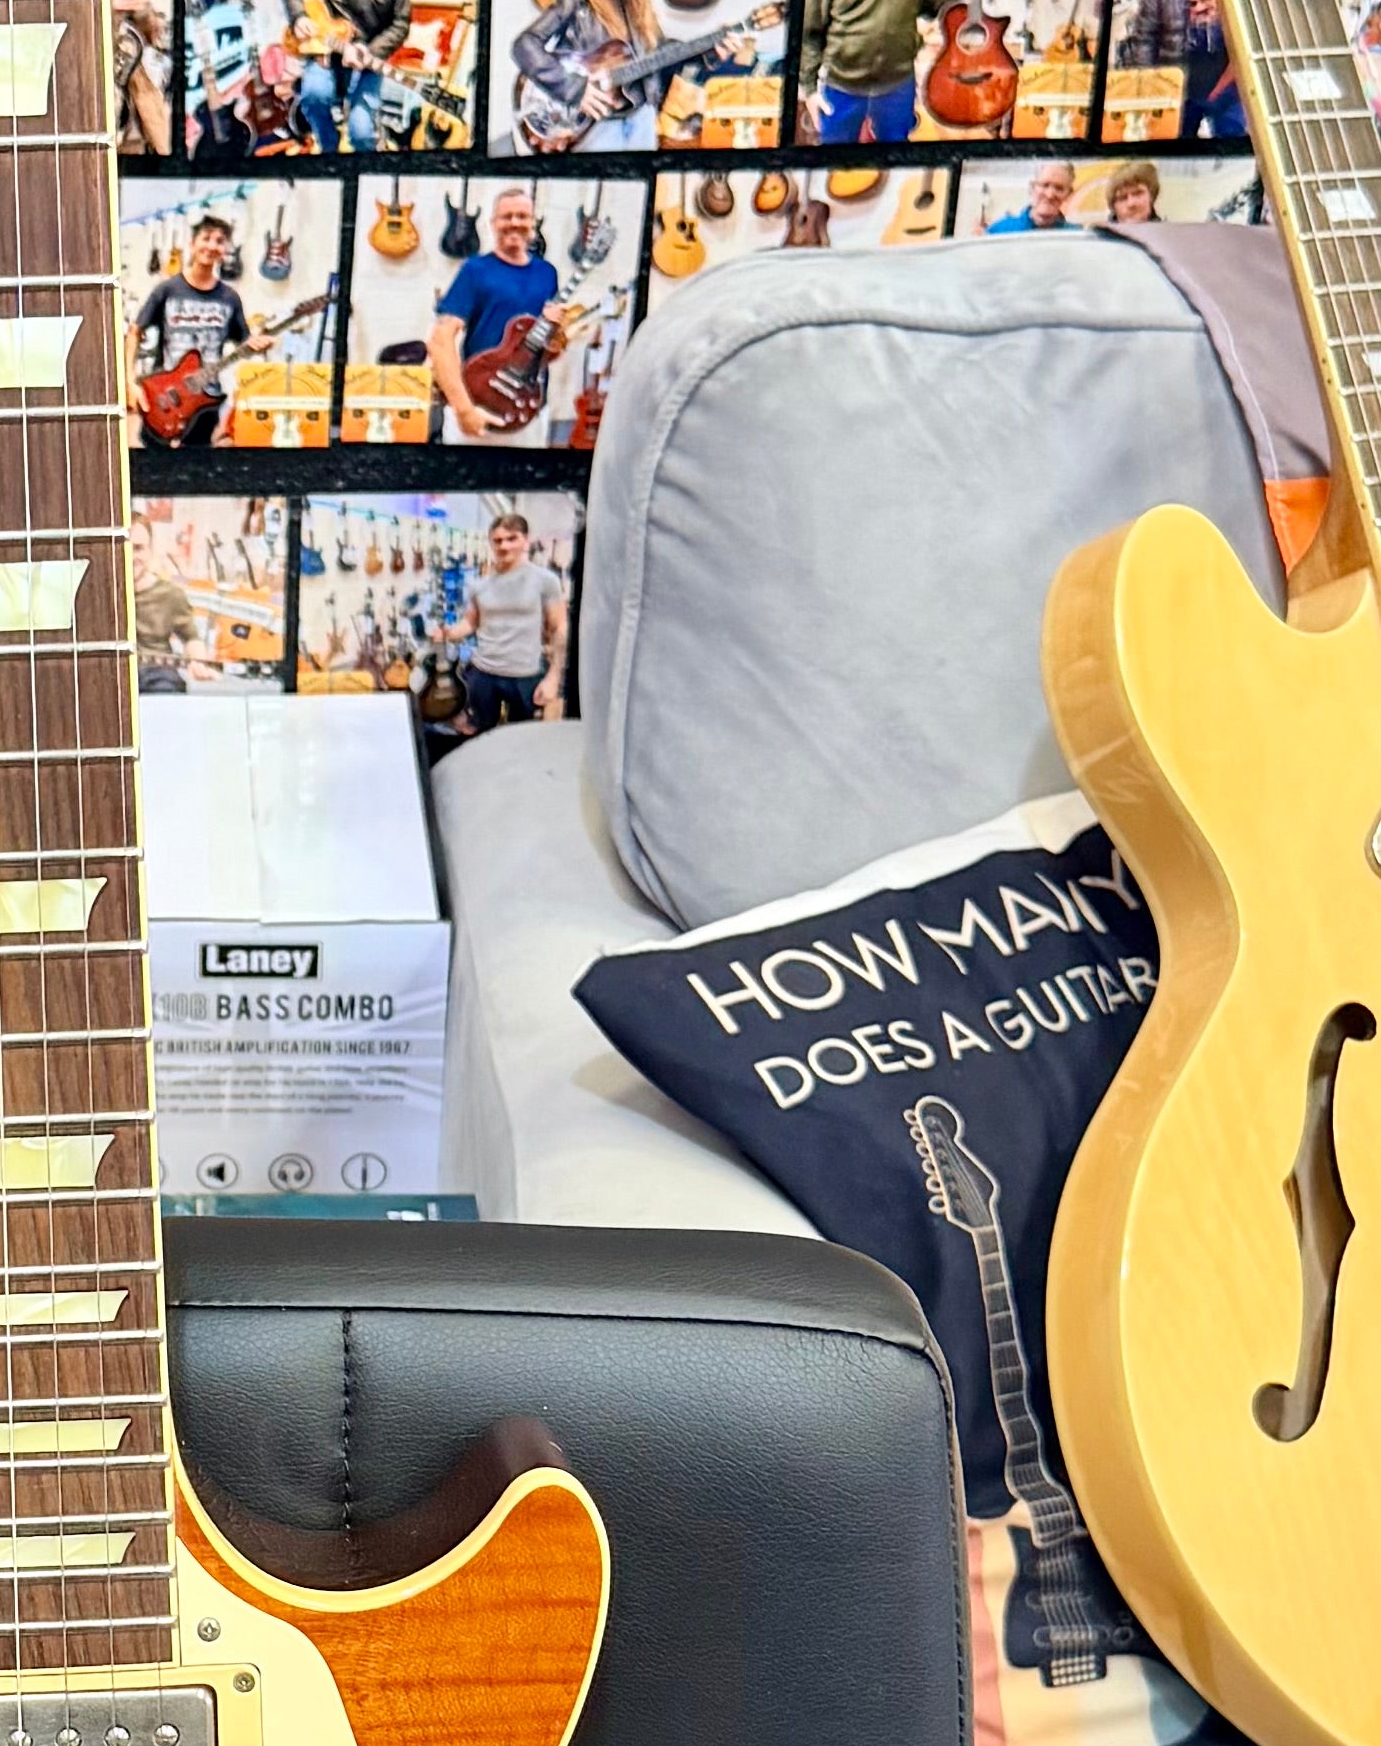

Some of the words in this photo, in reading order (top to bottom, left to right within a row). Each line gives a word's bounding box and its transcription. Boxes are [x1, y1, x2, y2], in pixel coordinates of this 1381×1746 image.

[686, 918, 919, 1036] HOW
[917, 847, 1141, 976] MANY
[205, 944, 314, 978] Laney
[216, 993, 290, 1021] BASS
[297, 993, 394, 1021] COMBO
[168, 1039, 221, 1055] BRITISH
[225, 1039, 332, 1055] AMPLIFICATION
[335, 1039, 376, 1055] SINCE
[753, 1018, 937, 1111] DOES
[941, 1010, 994, 1062] A
